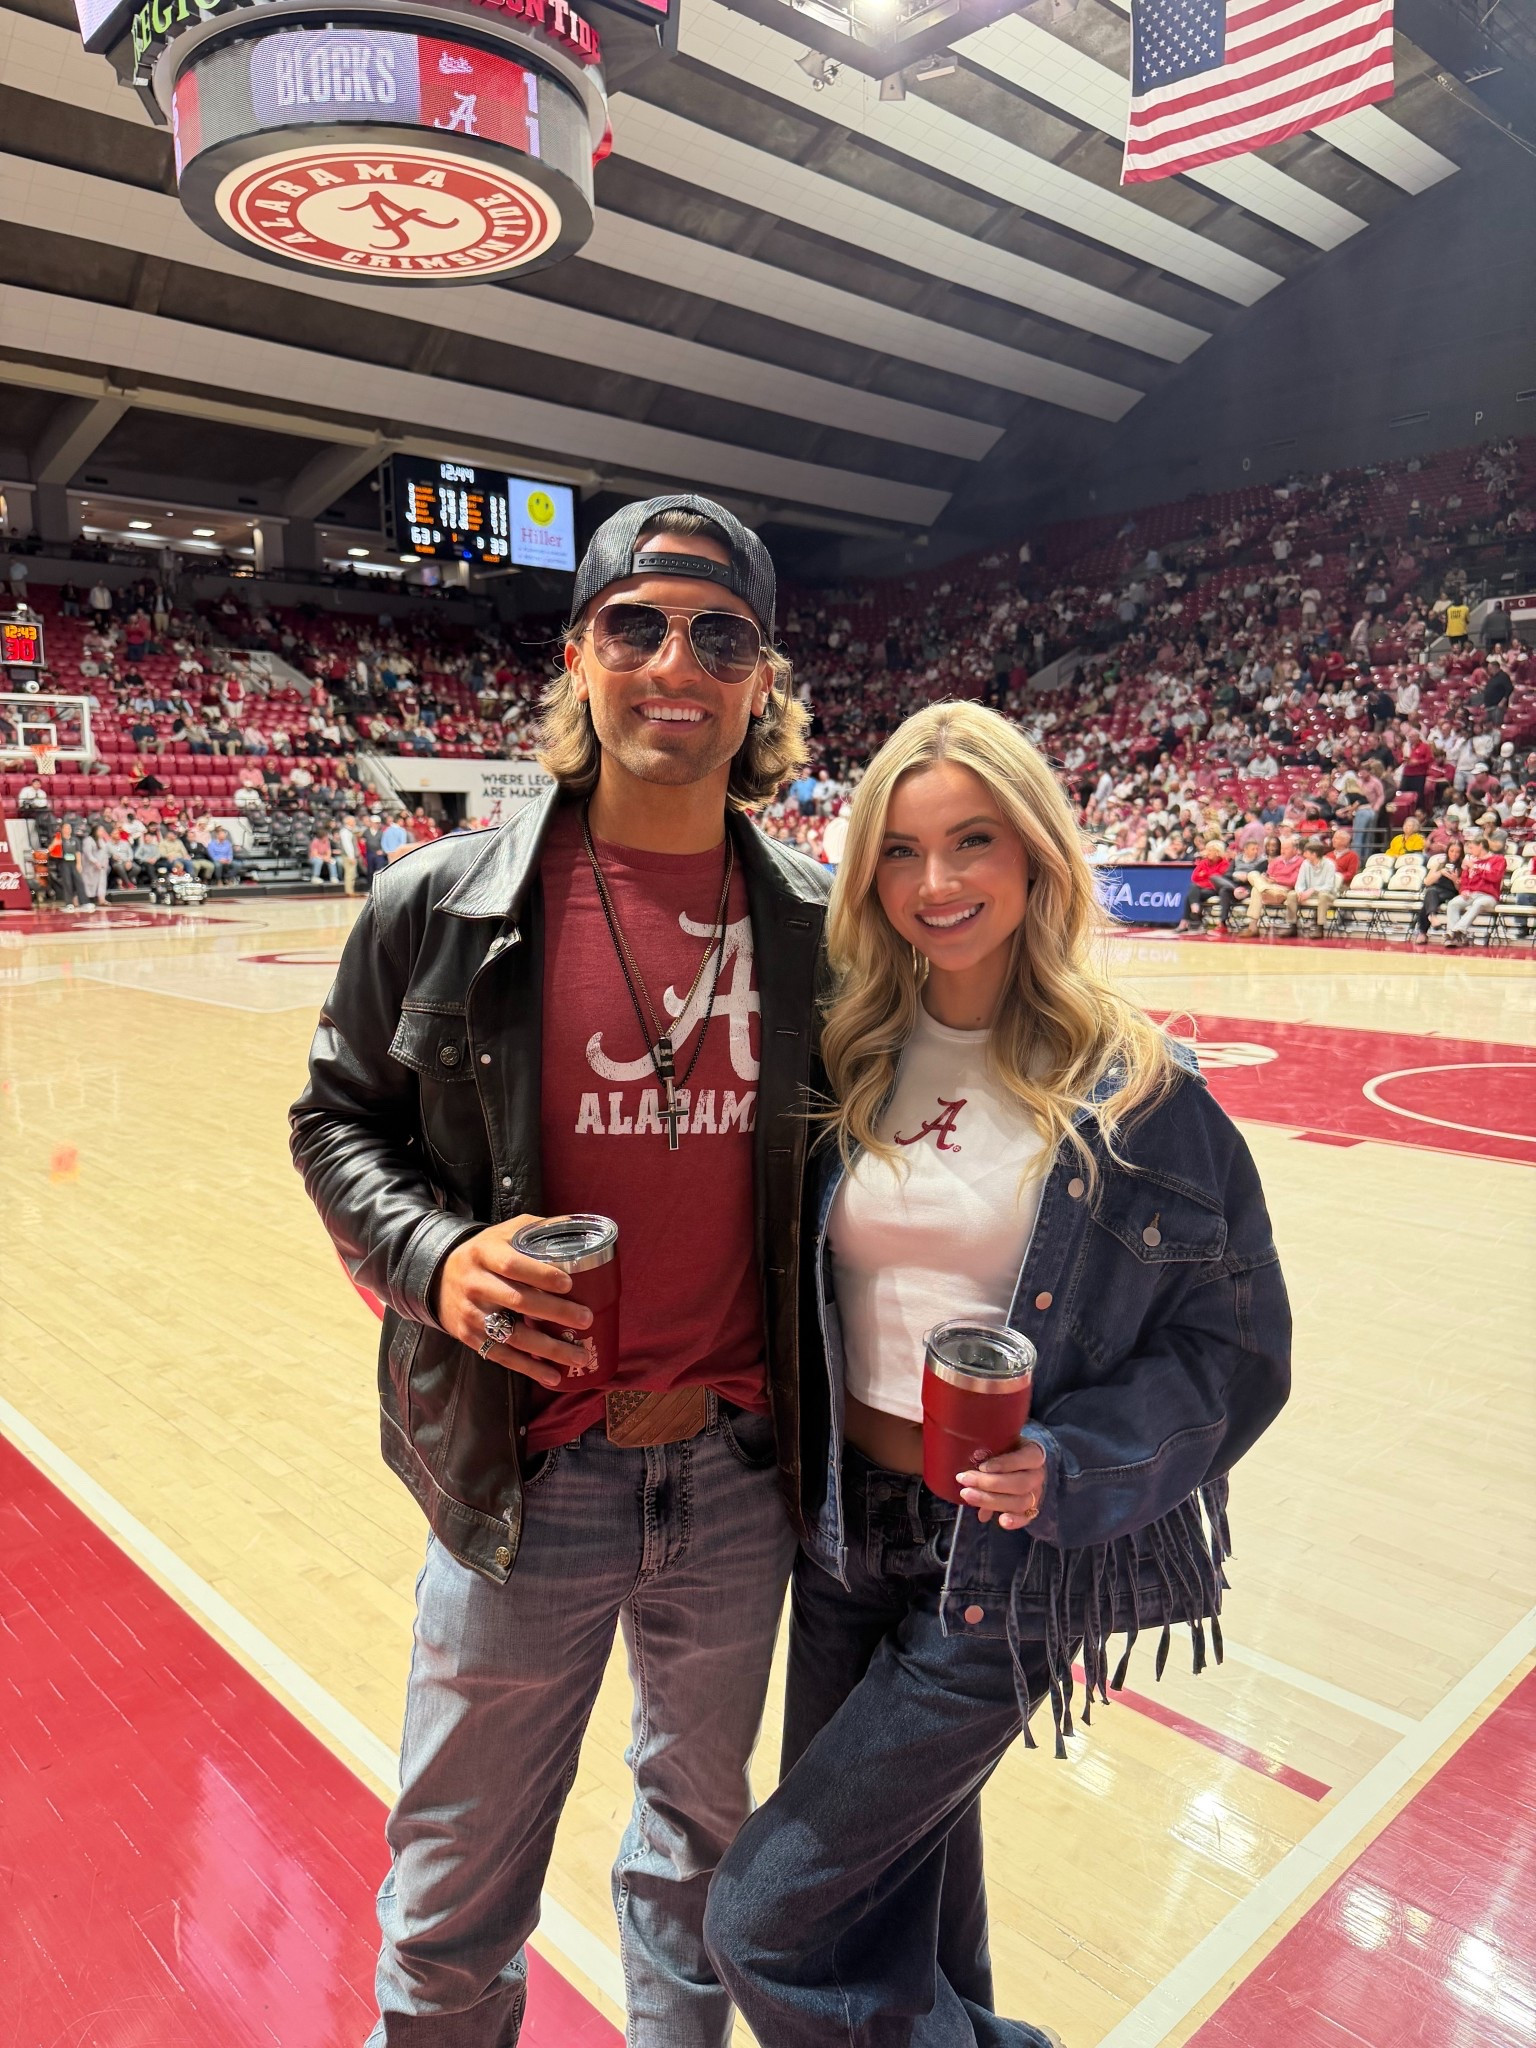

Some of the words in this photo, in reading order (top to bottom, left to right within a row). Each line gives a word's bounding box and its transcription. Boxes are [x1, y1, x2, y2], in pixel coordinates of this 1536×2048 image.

[276, 46, 397, 106] BLOCKS
[254, 163, 448, 245] ALABAMA
[341, 238, 517, 270] CRIMSON
[473, 193, 527, 239] TIDE
[1474, 411, 1484, 426] P
[520, 527, 563, 547] Hiller
[4, 625, 37, 641] 12:43
[6, 638, 36, 661] 30
[481, 773, 523, 786] WHERE
[482, 786, 504, 798] ARE
[510, 787, 545, 798] MADE
[585, 910, 762, 1082] A
[574, 1088, 757, 1134] ALABAM
[893, 1096, 968, 1151] A
